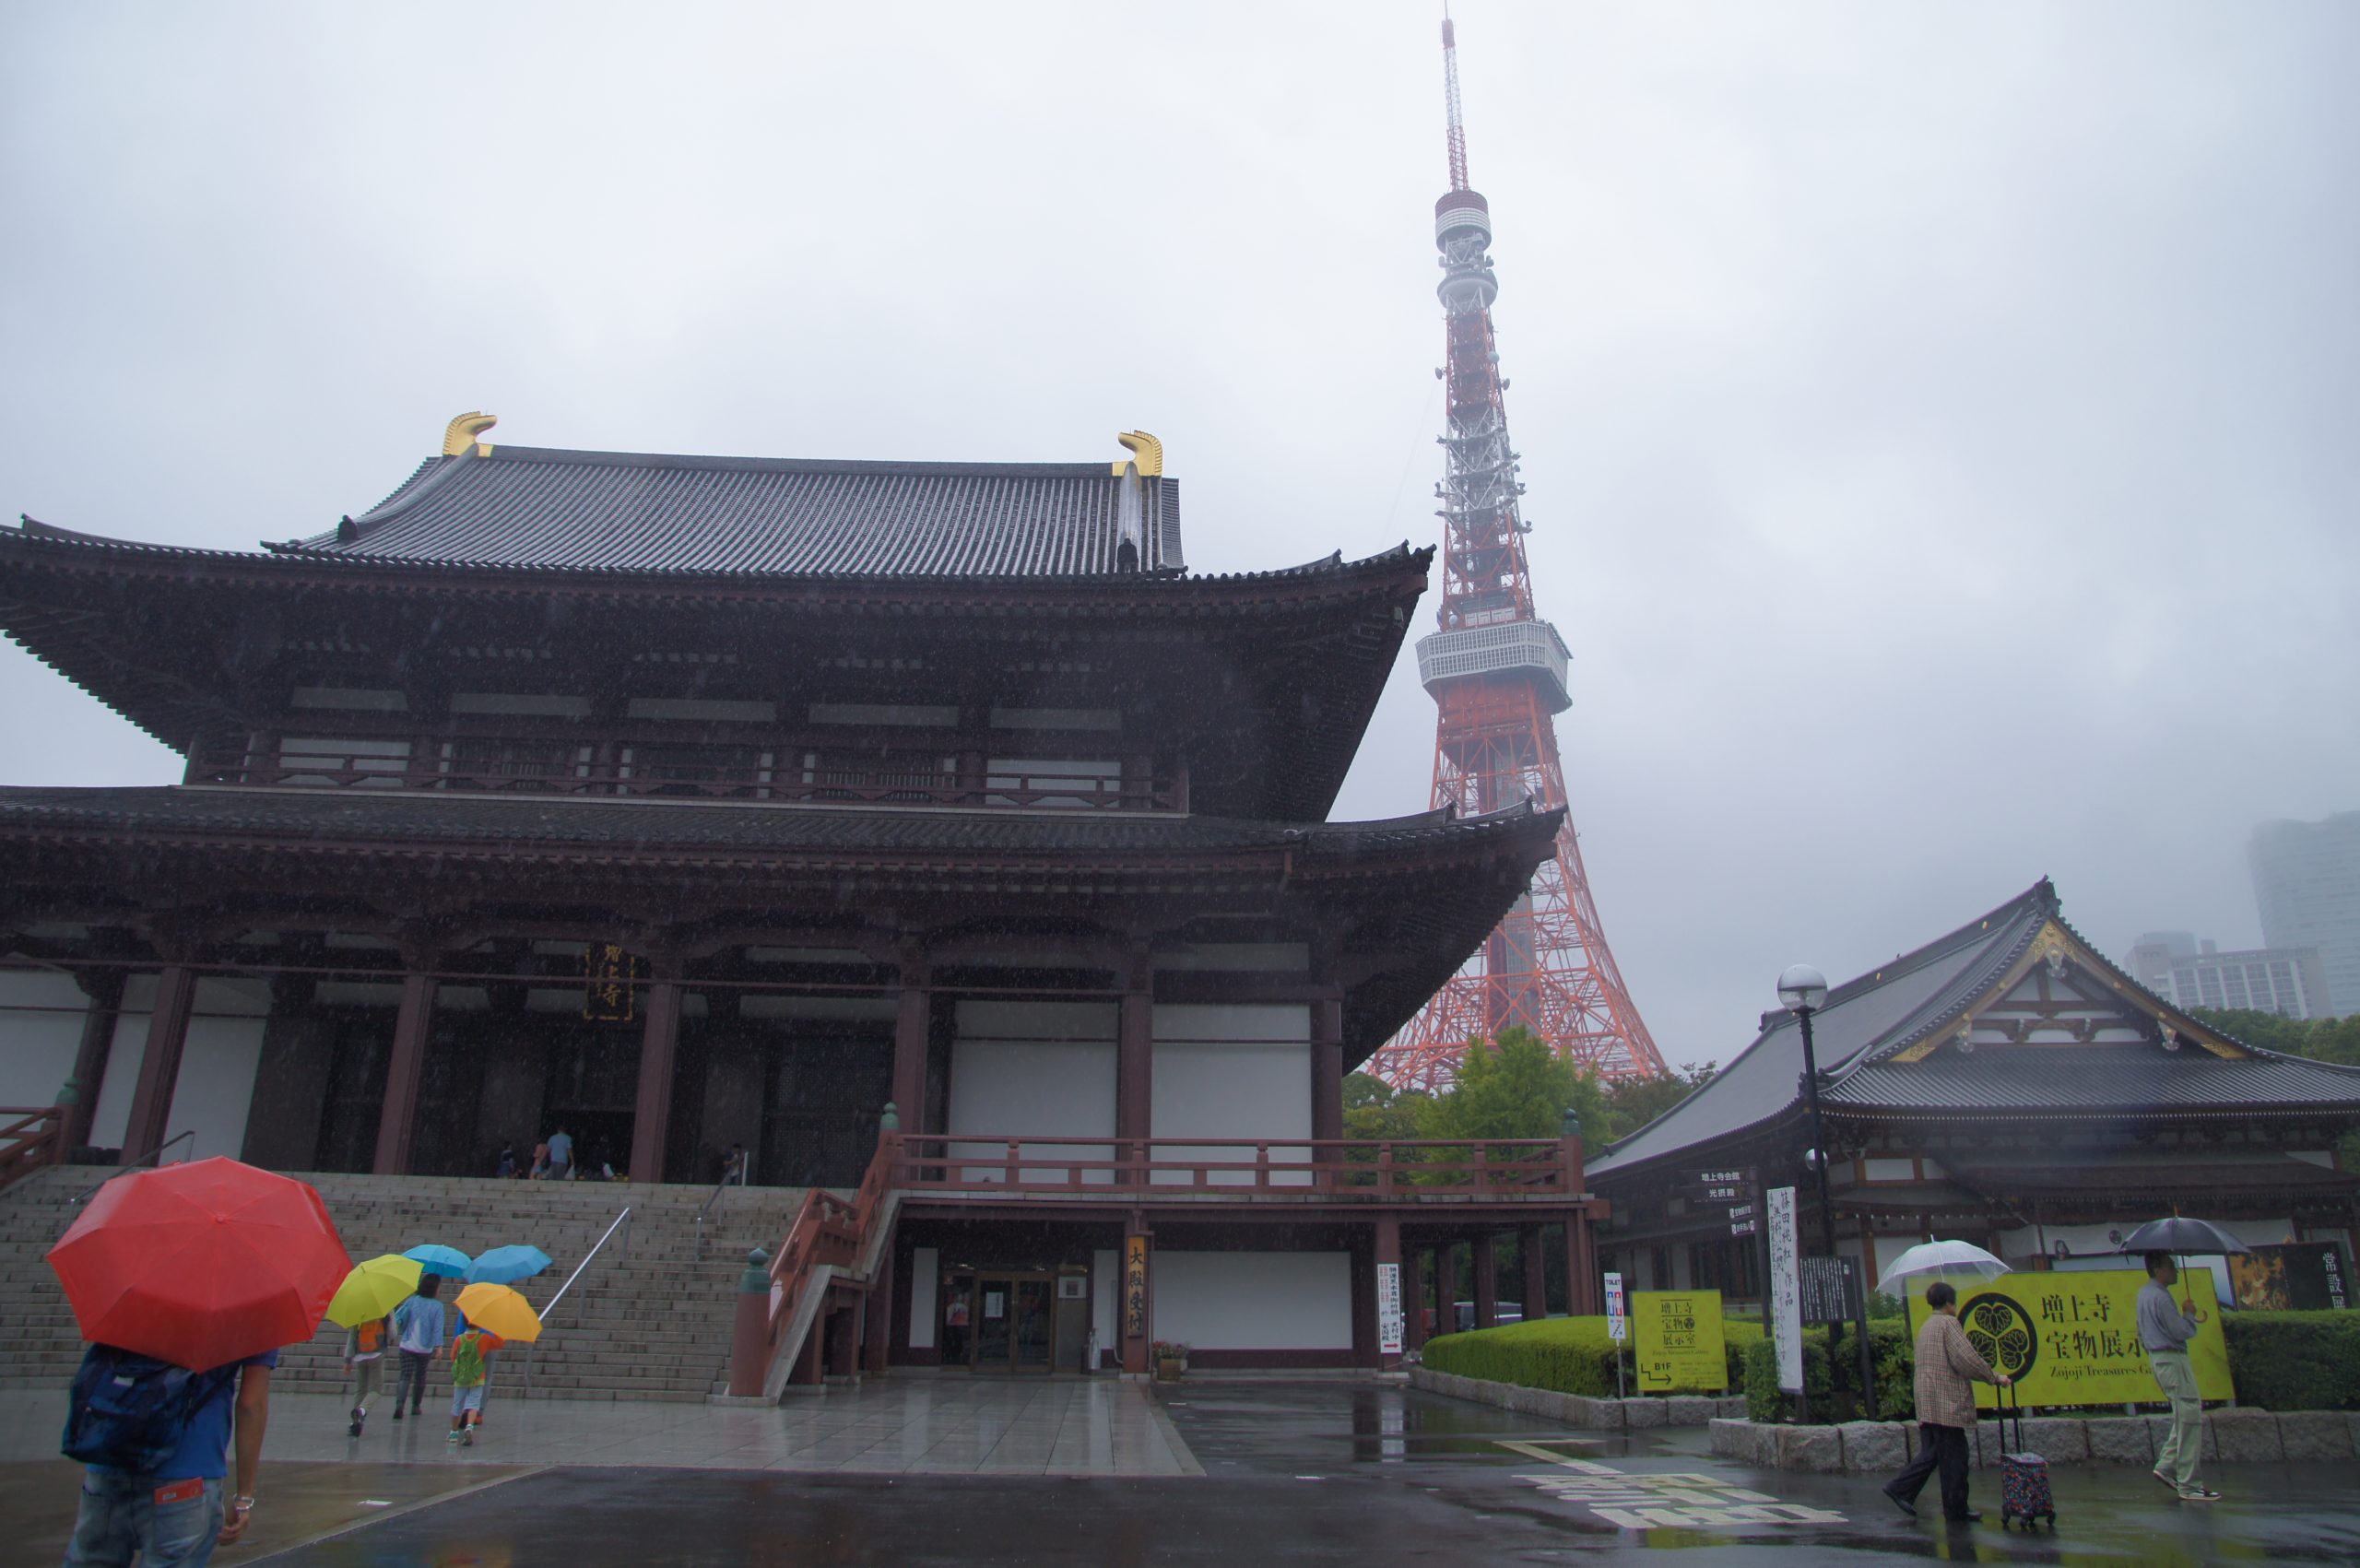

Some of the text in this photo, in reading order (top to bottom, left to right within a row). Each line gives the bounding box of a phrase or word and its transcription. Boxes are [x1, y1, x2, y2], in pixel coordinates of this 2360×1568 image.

[1701, 1172, 1740, 1182] 増上寺会館
[2323, 1252, 2346, 1308] 常設展
[1128, 1246, 1144, 1331] 大殿受付
[1661, 1303, 1693, 1314] 増上寺
[2040, 1294, 2110, 1323] 増上寺
[1662, 1317, 1683, 1330] 宝物
[1663, 1333, 1694, 1345] 展示室
[2046, 1330, 2142, 1359] 宝物展示
[1655, 1362, 1671, 1371] B1F
[2050, 1364, 2083, 1381] Zojoji
[2085, 1364, 2137, 1376] Treasures
